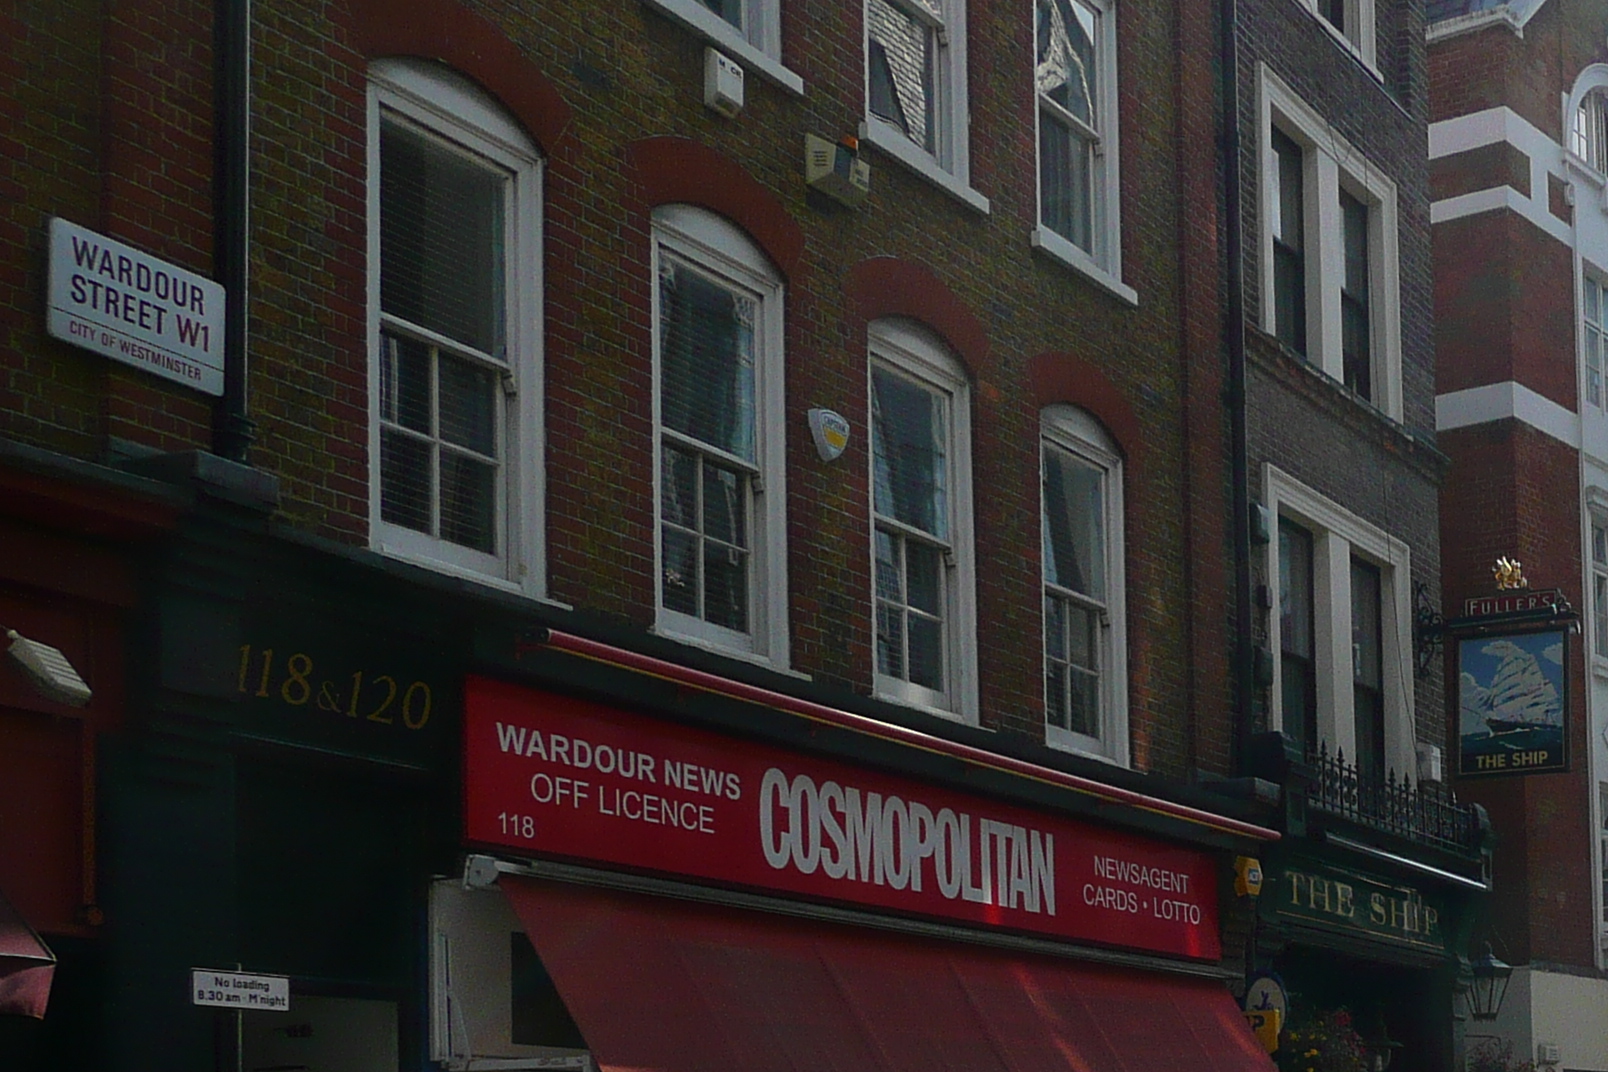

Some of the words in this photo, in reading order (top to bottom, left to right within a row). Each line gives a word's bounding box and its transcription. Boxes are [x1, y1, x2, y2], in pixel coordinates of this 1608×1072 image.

[72, 236, 204, 316] WARDOUR
[70, 274, 168, 335] STREET
[176, 314, 210, 353] W1
[69, 320, 97, 342] CITY
[101, 332, 117, 348] OF
[119, 339, 202, 381] WESTMINSTER
[1469, 595, 1550, 617] FULLER'S
[496, 721, 657, 784] WARDOUR
[664, 759, 742, 800] NEWS
[1476, 753, 1506, 769] THE
[1512, 750, 1548, 767] SHIP
[497, 811, 535, 839] 118
[530, 772, 590, 809] OFF
[599, 785, 715, 834] LICENCE
[759, 767, 1056, 916] COSMOPOLITAN
[1093, 854, 1188, 895] NEWSAGENT
[1083, 884, 1138, 914] CARDS
[1153, 896, 1200, 925] LOTTO
[1284, 870, 1355, 918] THE
[1369, 891, 1439, 936] SHIP
[197, 990, 223, 1001] 8.30
[225, 994, 240, 1003] am
[214, 976, 230, 988] No
[232, 978, 270, 992] loading
